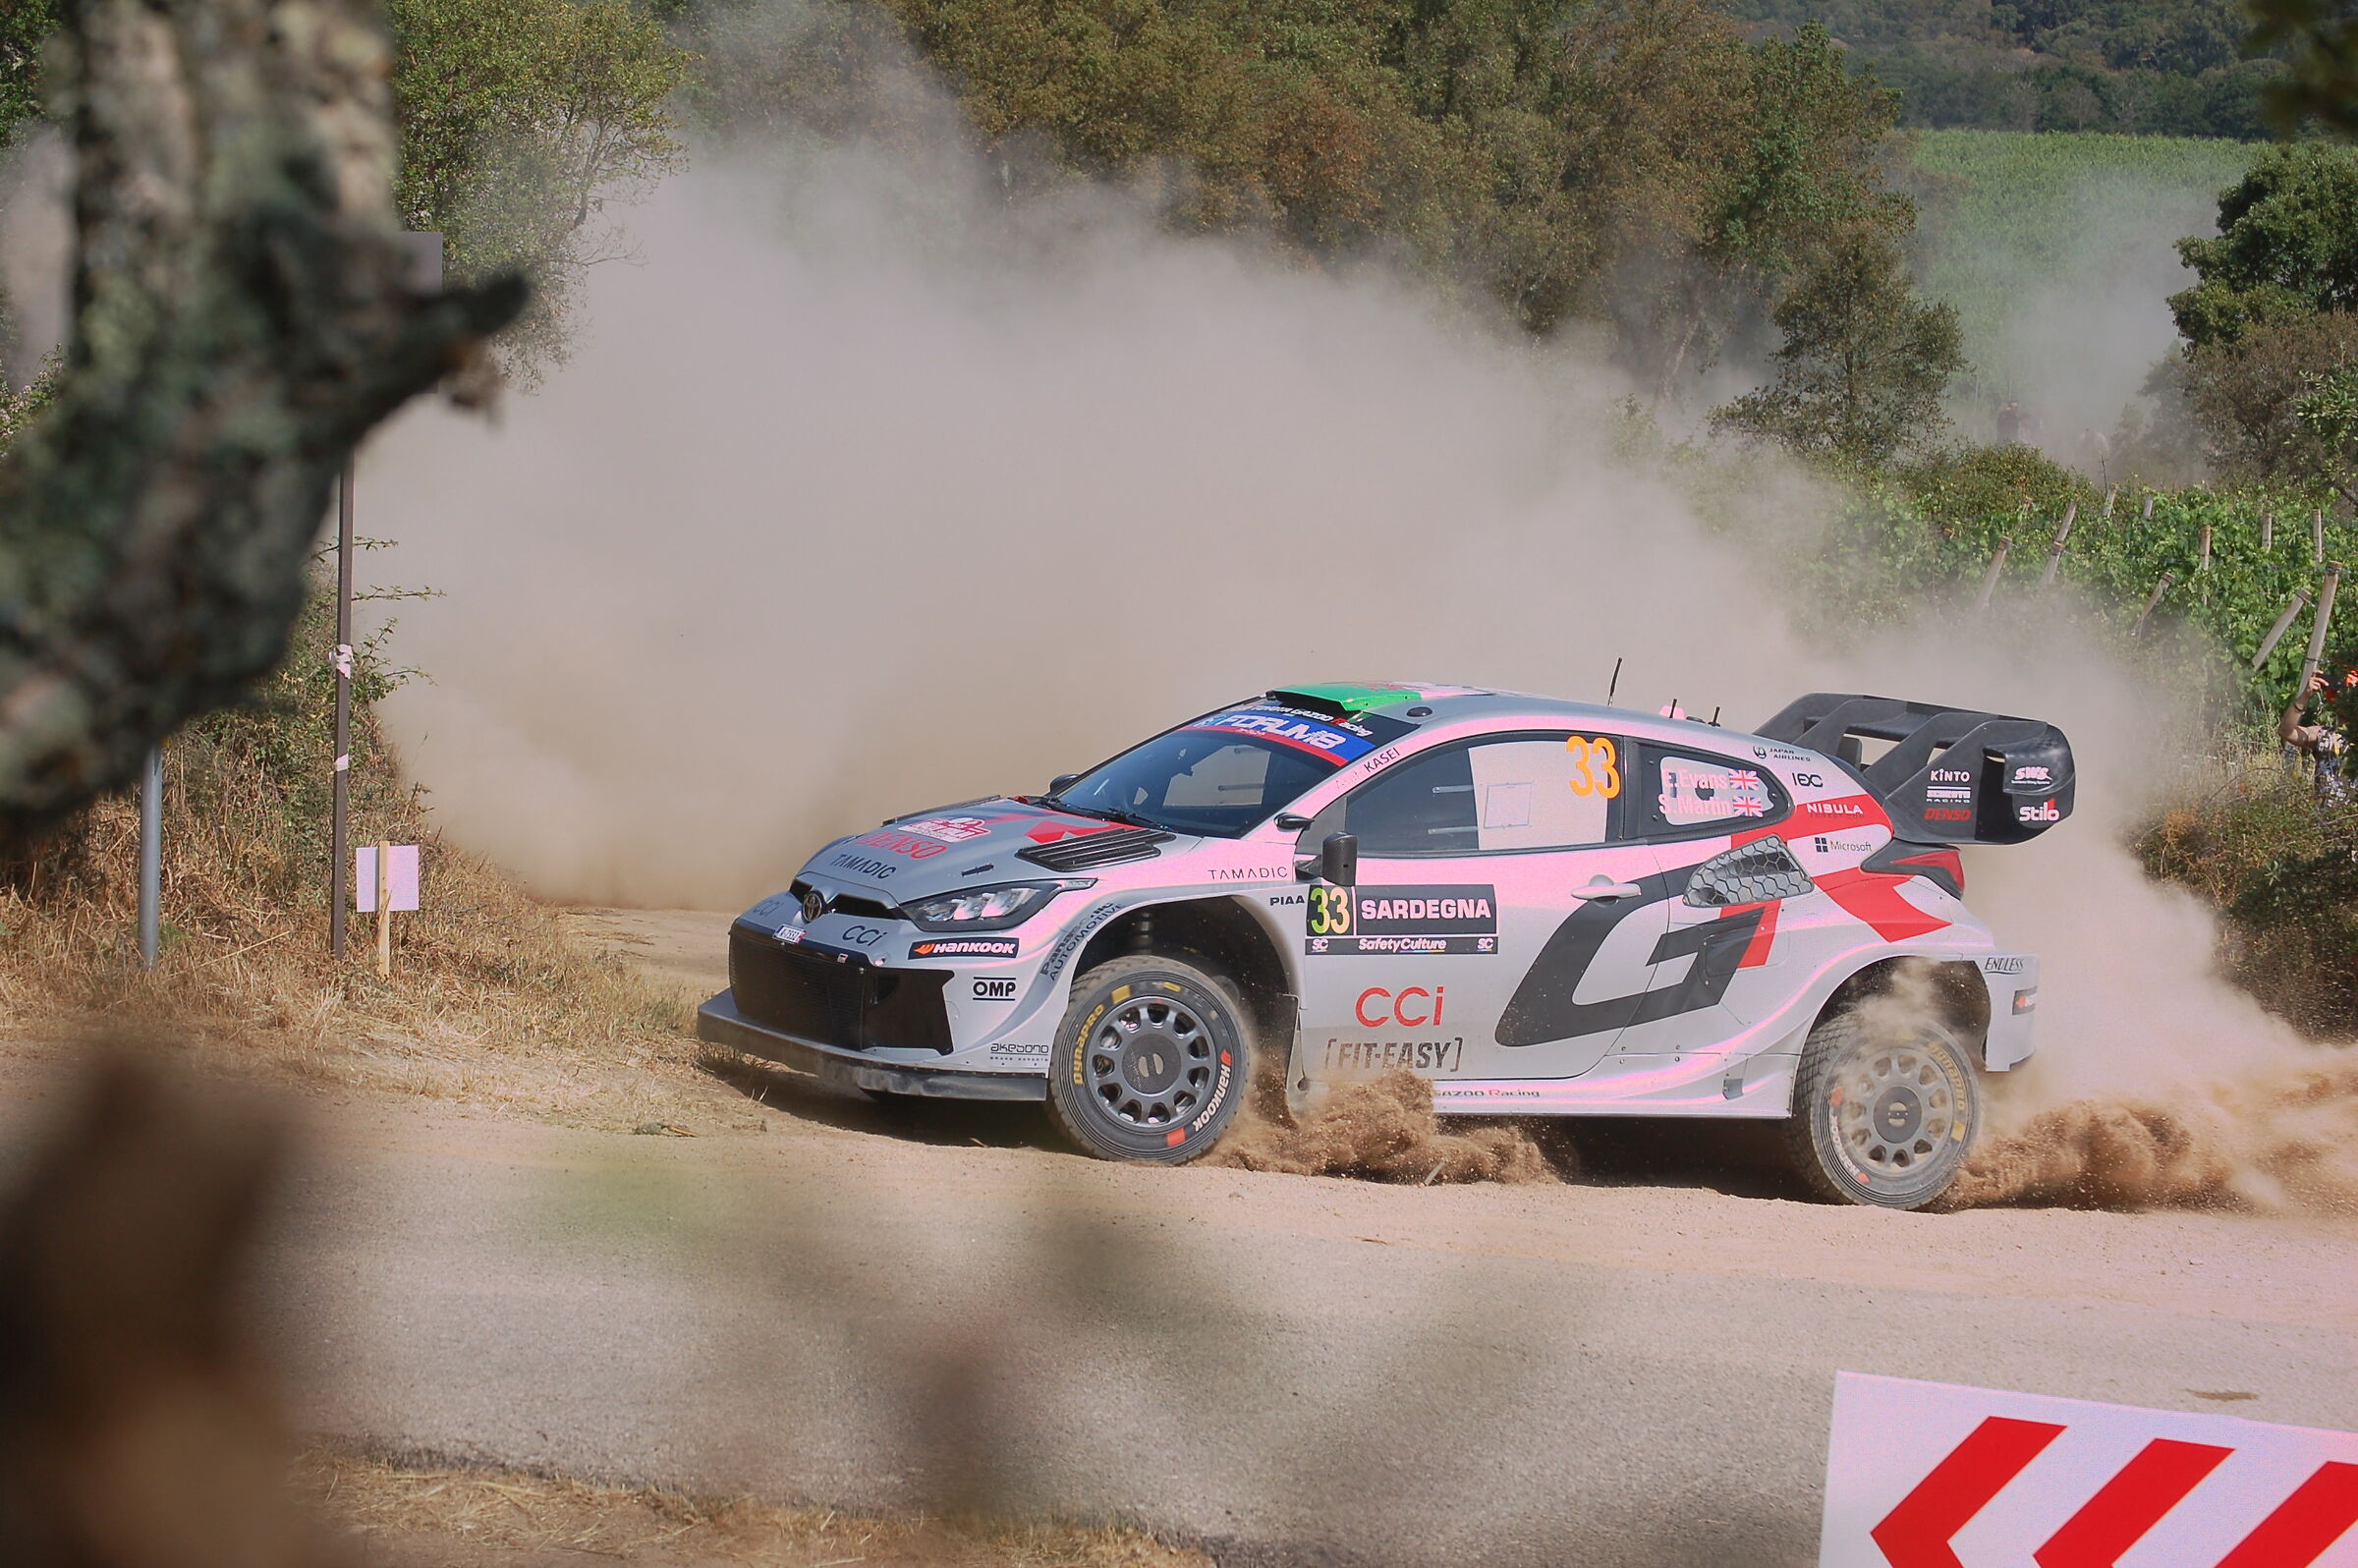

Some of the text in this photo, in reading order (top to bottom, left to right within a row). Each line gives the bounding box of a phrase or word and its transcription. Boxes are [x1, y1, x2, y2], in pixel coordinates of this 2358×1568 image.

[1215, 714, 1347, 750] FORUM8
[1363, 747, 1401, 774] KASEI
[1566, 736, 1621, 799] 33
[1806, 803, 1864, 814] NISULA
[1923, 808, 1972, 821] DENSO
[2019, 800, 2060, 821] Stilo
[854, 830, 949, 860] DENSO
[1830, 841, 1873, 852] Microsoft
[829, 853, 897, 879] TAMADIC
[1207, 867, 1289, 880] TAMADIC
[1269, 895, 1306, 907] PIAA
[1310, 887, 1491, 934] 33 SARDEGNA
[1358, 938, 1448, 953] SafetyCulture
[1985, 957, 2025, 972] ENDLESS
[973, 981, 1016, 997] OMP
[1488, 1088, 1541, 1097] Racing
